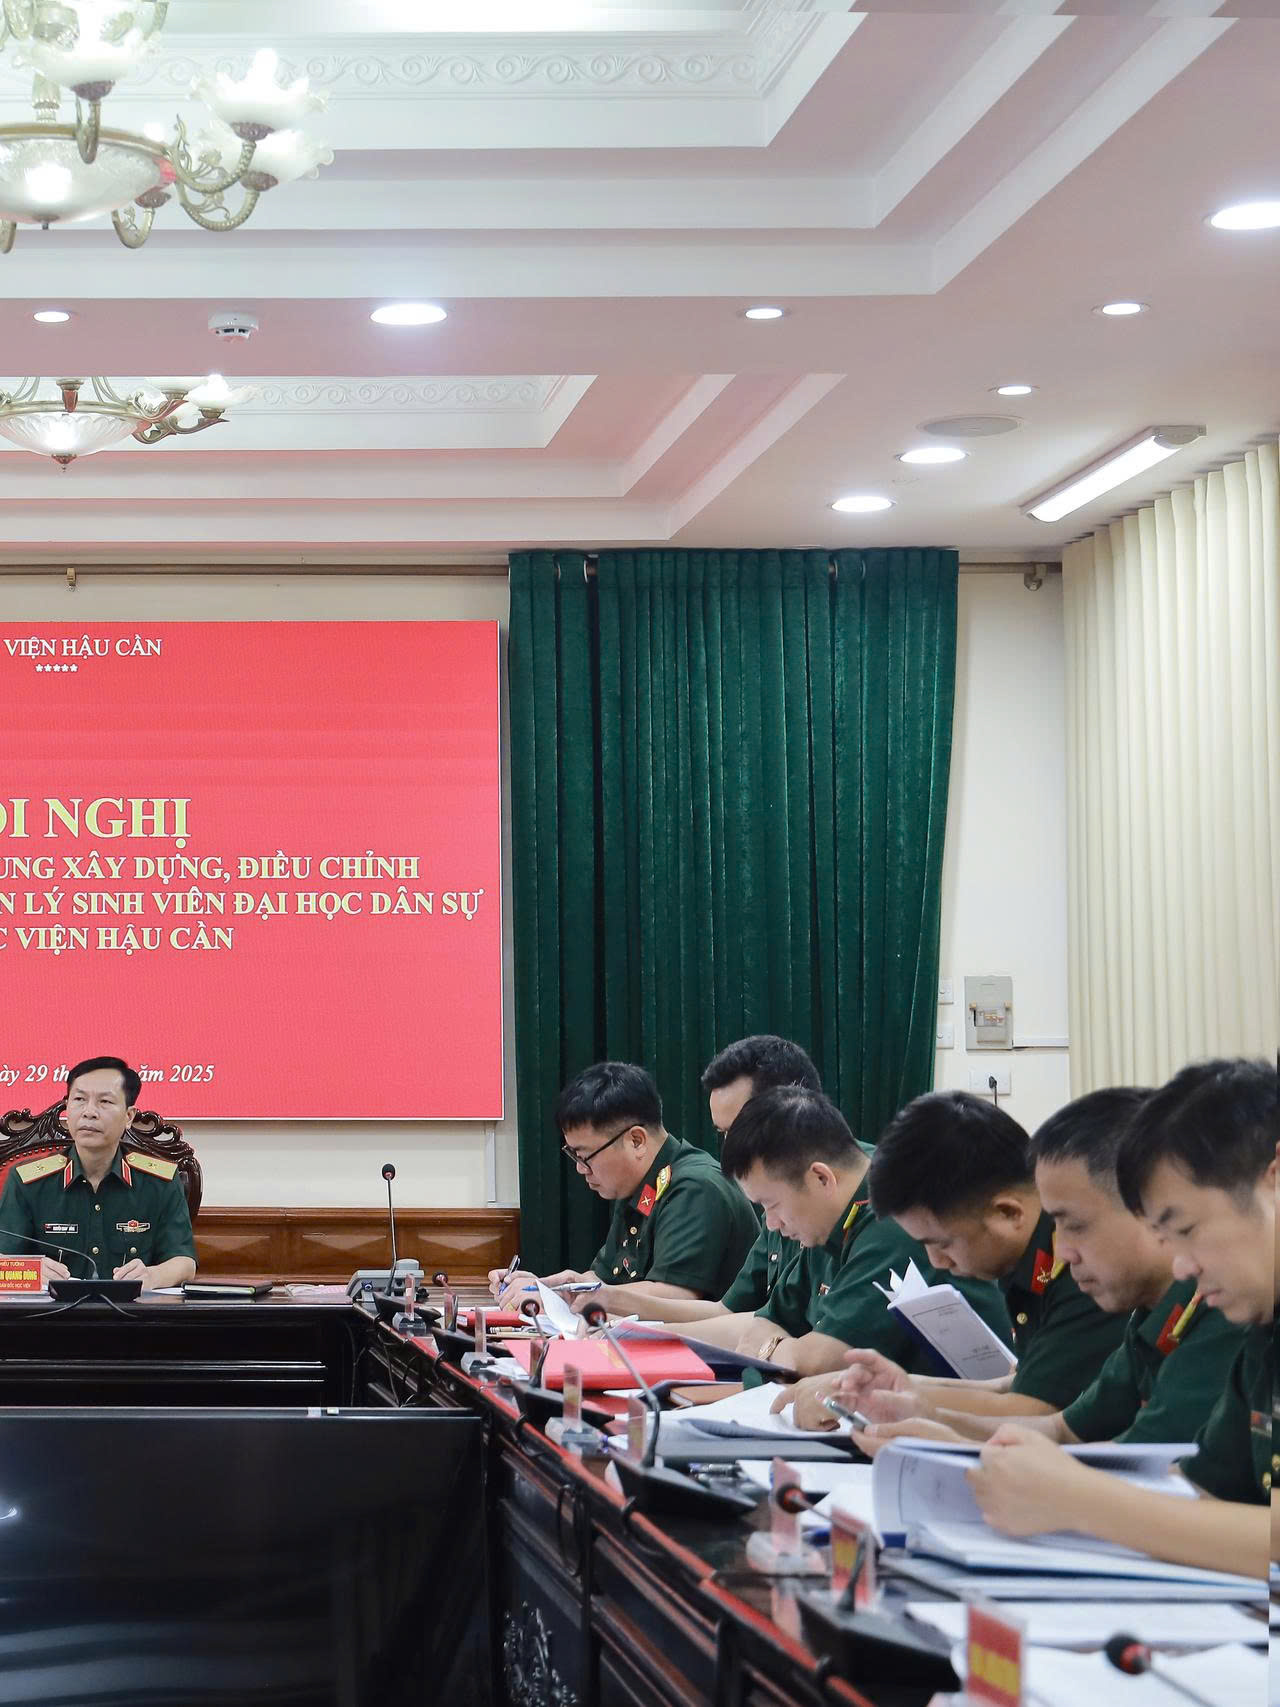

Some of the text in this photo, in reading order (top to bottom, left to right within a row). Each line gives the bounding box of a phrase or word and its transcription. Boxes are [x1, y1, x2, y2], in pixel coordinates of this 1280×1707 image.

[3, 636, 57, 660] VIỆN
[61, 634, 111, 660] HẬU
[115, 634, 162, 656] CẦN
[43, 797, 192, 849] NGHỊ
[61, 850, 127, 879] XÂY
[133, 853, 231, 885] DỰNG,
[237, 850, 313, 879] ĐIỀU
[319, 850, 420, 879] CHỈNH
[23, 885, 65, 915] LÝ
[72, 892, 145, 915] SINH
[151, 885, 226, 915] VIÊN
[233, 892, 289, 921] ĐẠI
[295, 892, 362, 921] HỌC
[370, 885, 435, 915] DÂN
[442, 888, 485, 921] SỰ
[14, 923, 90, 956] VIỆN
[96, 923, 163, 956] HẬU
[169, 920, 234, 950] CẦN
[24, 1064, 48, 1082] 29
[137, 1064, 164, 1082] ăm
[169, 1064, 215, 1082] 2025
